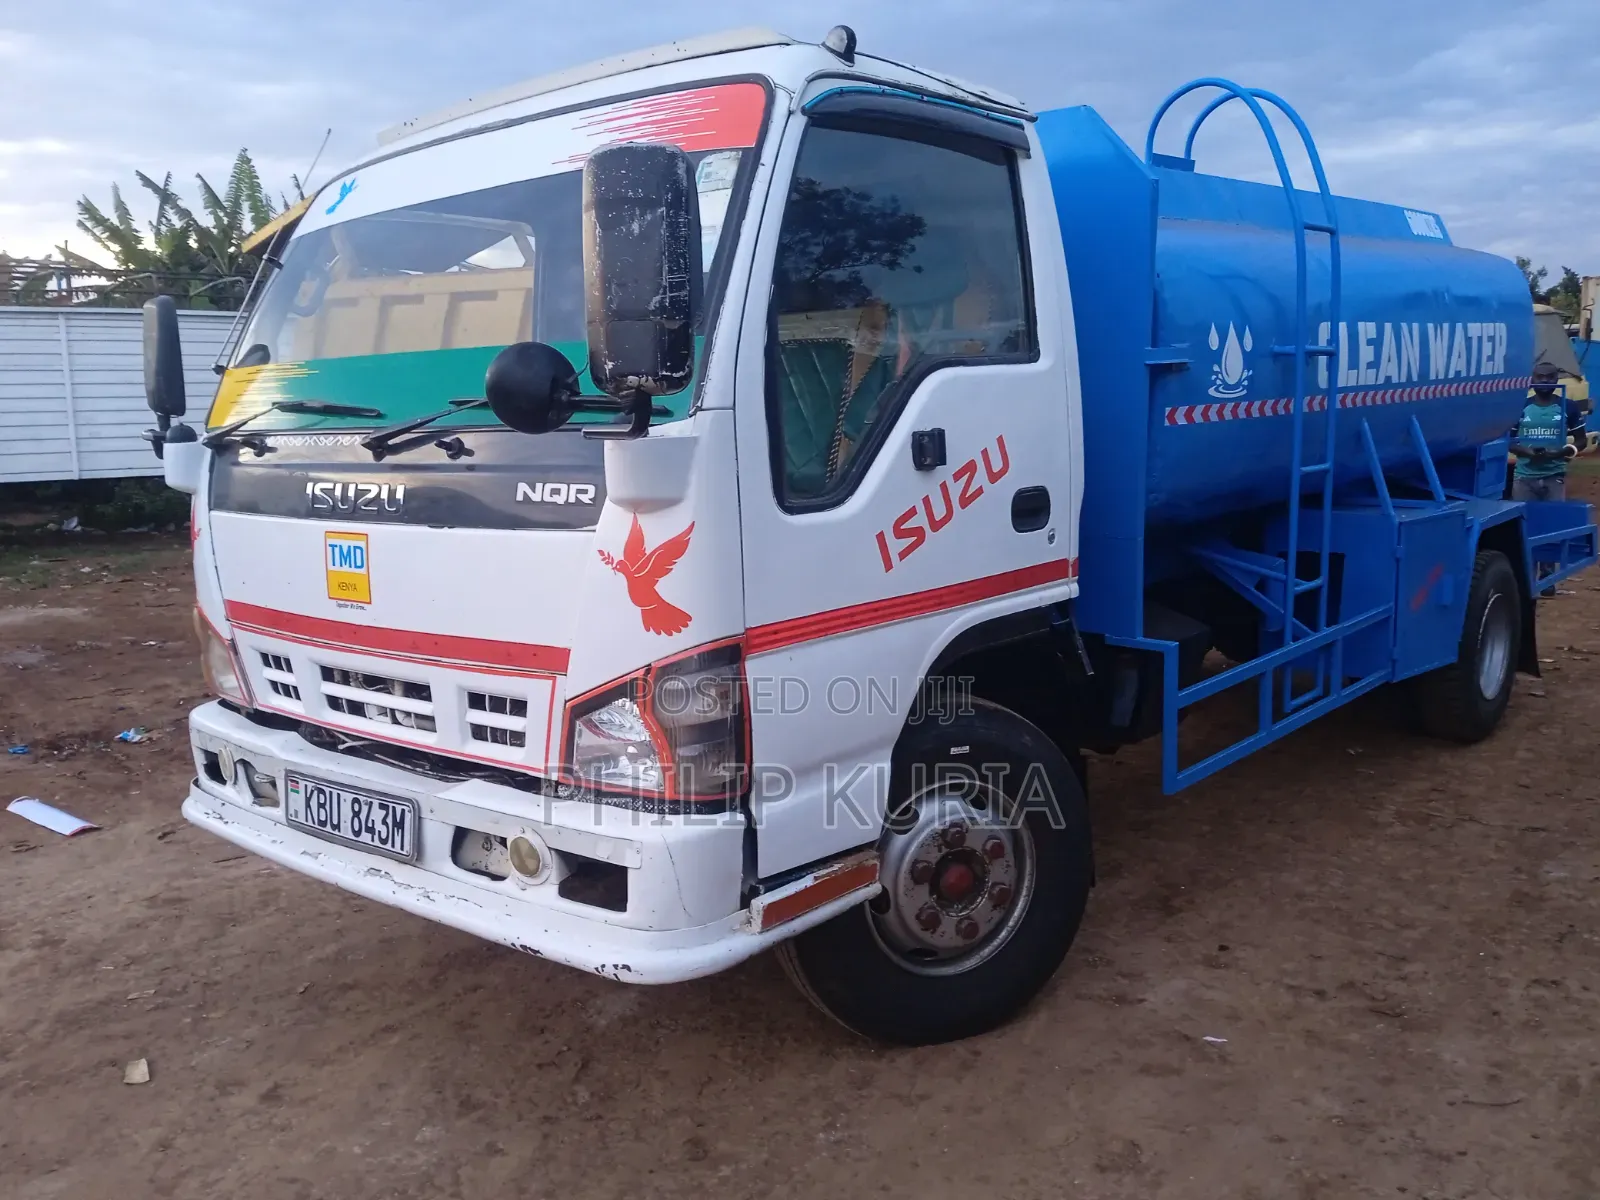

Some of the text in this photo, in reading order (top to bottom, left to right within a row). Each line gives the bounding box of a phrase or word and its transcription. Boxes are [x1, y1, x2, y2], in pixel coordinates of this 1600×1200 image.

[1318, 321, 1507, 389] CLEAN WATER
[1523, 427, 1561, 436] Emirate
[305, 481, 407, 514] ISUZU
[516, 482, 596, 505] NQR
[875, 434, 1010, 573] ISUZU
[328, 543, 365, 569] TMD
[337, 580, 358, 592] KENYA
[304, 783, 406, 852] KBU 843M
